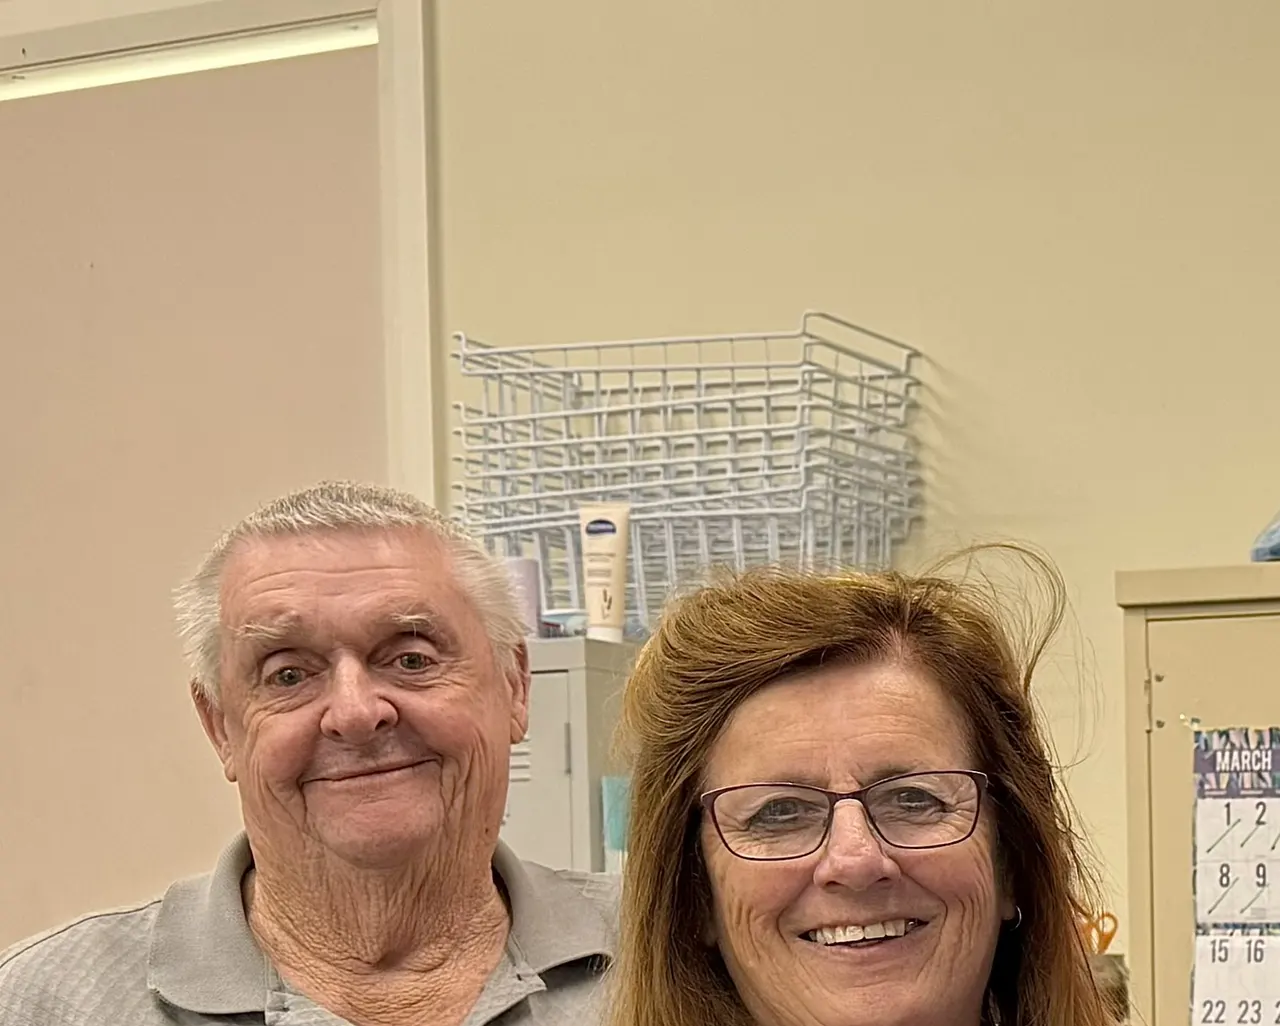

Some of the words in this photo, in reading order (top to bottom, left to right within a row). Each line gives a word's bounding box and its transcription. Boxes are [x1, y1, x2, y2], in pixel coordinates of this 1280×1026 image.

[1216, 750, 1272, 771] MARCH
[1224, 801, 1231, 825] 1
[1255, 801, 1267, 825] 2
[1219, 863, 1230, 887] 8
[1255, 863, 1267, 887] 9
[1210, 939, 1228, 963] 15
[1246, 939, 1264, 963] 16
[1202, 1000, 1226, 1024] 22
[1237, 1000, 1262, 1024] 23
